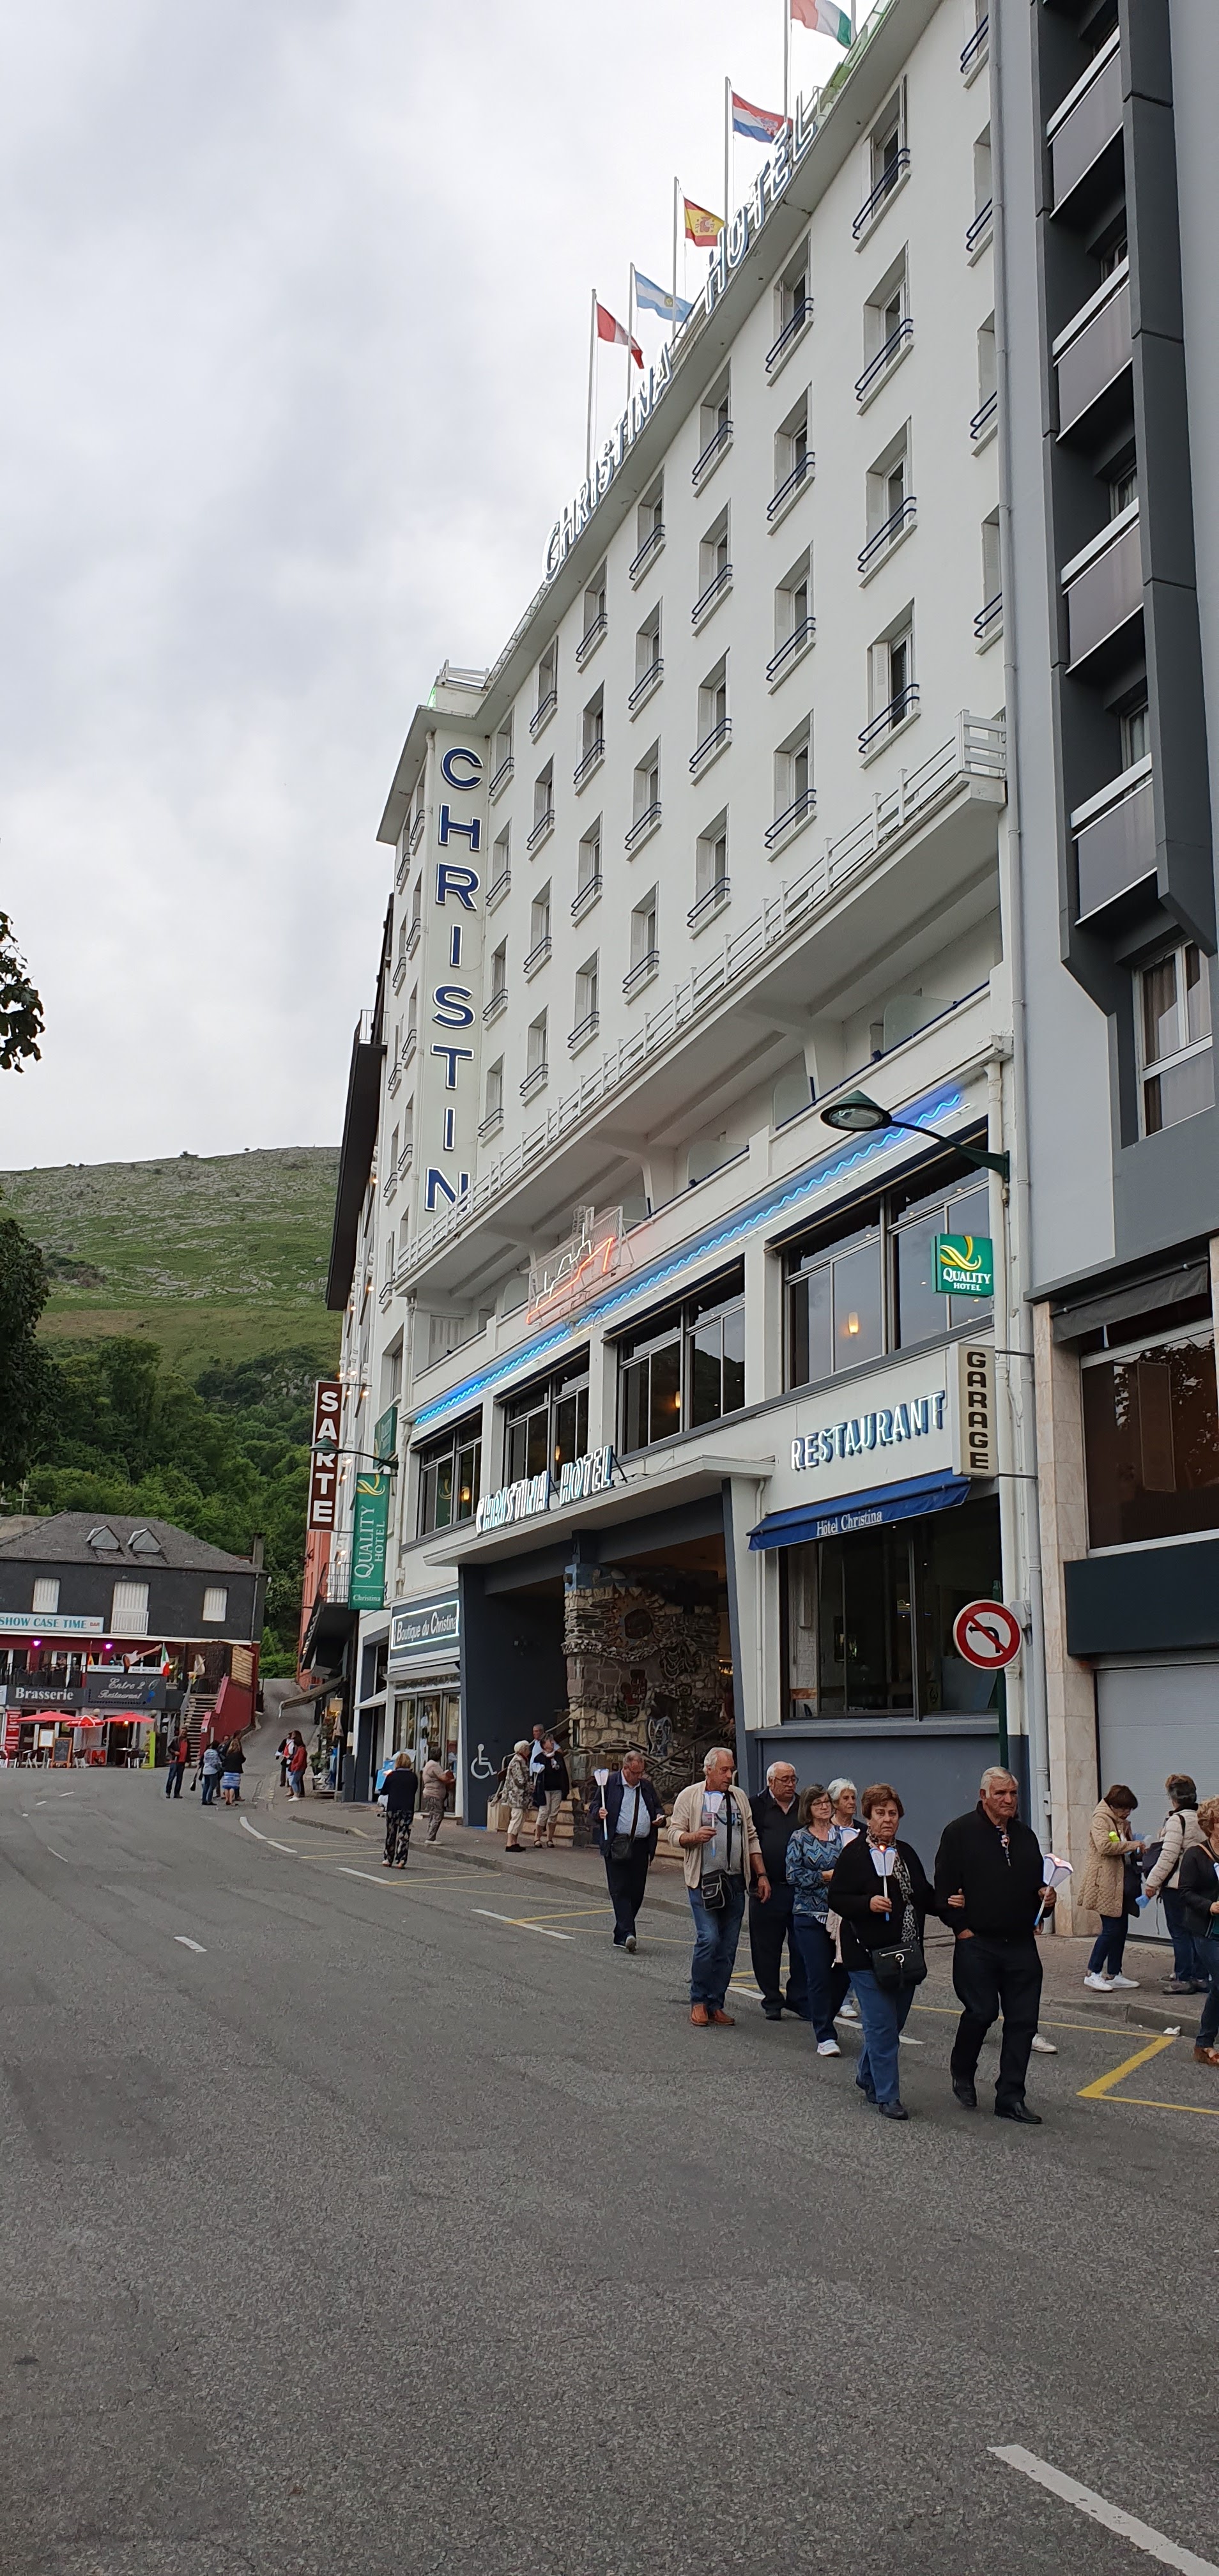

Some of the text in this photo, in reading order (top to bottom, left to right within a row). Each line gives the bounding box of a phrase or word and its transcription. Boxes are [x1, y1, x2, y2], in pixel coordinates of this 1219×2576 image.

[542, 90, 816, 584] CHRISTINA HOTEL
[943, 1267, 992, 1284] QUALITY
[953, 1282, 982, 1291] HOTEL
[967, 1351, 989, 1469] GARAGE
[791, 1390, 946, 1471] RESTAURANT
[312, 1391, 339, 1522] SARTE
[476, 1445, 614, 1533] CHRISTINA HOTEL
[841, 1509, 882, 1530] Christina
[354, 1505, 375, 1579] QUALITY
[374, 1521, 385, 1563] HOTEL
[0, 1616, 30, 1626] SHOW
[33, 1618, 59, 1628] CASE
[63, 1619, 87, 1629] TIME
[397, 1621, 420, 1642] Boutique
[422, 1620, 429, 1637] du
[15, 1687, 74, 1700] Brasserie
[98, 1690, 142, 1699] Restaurant
[108, 1678, 135, 1689] Entre
